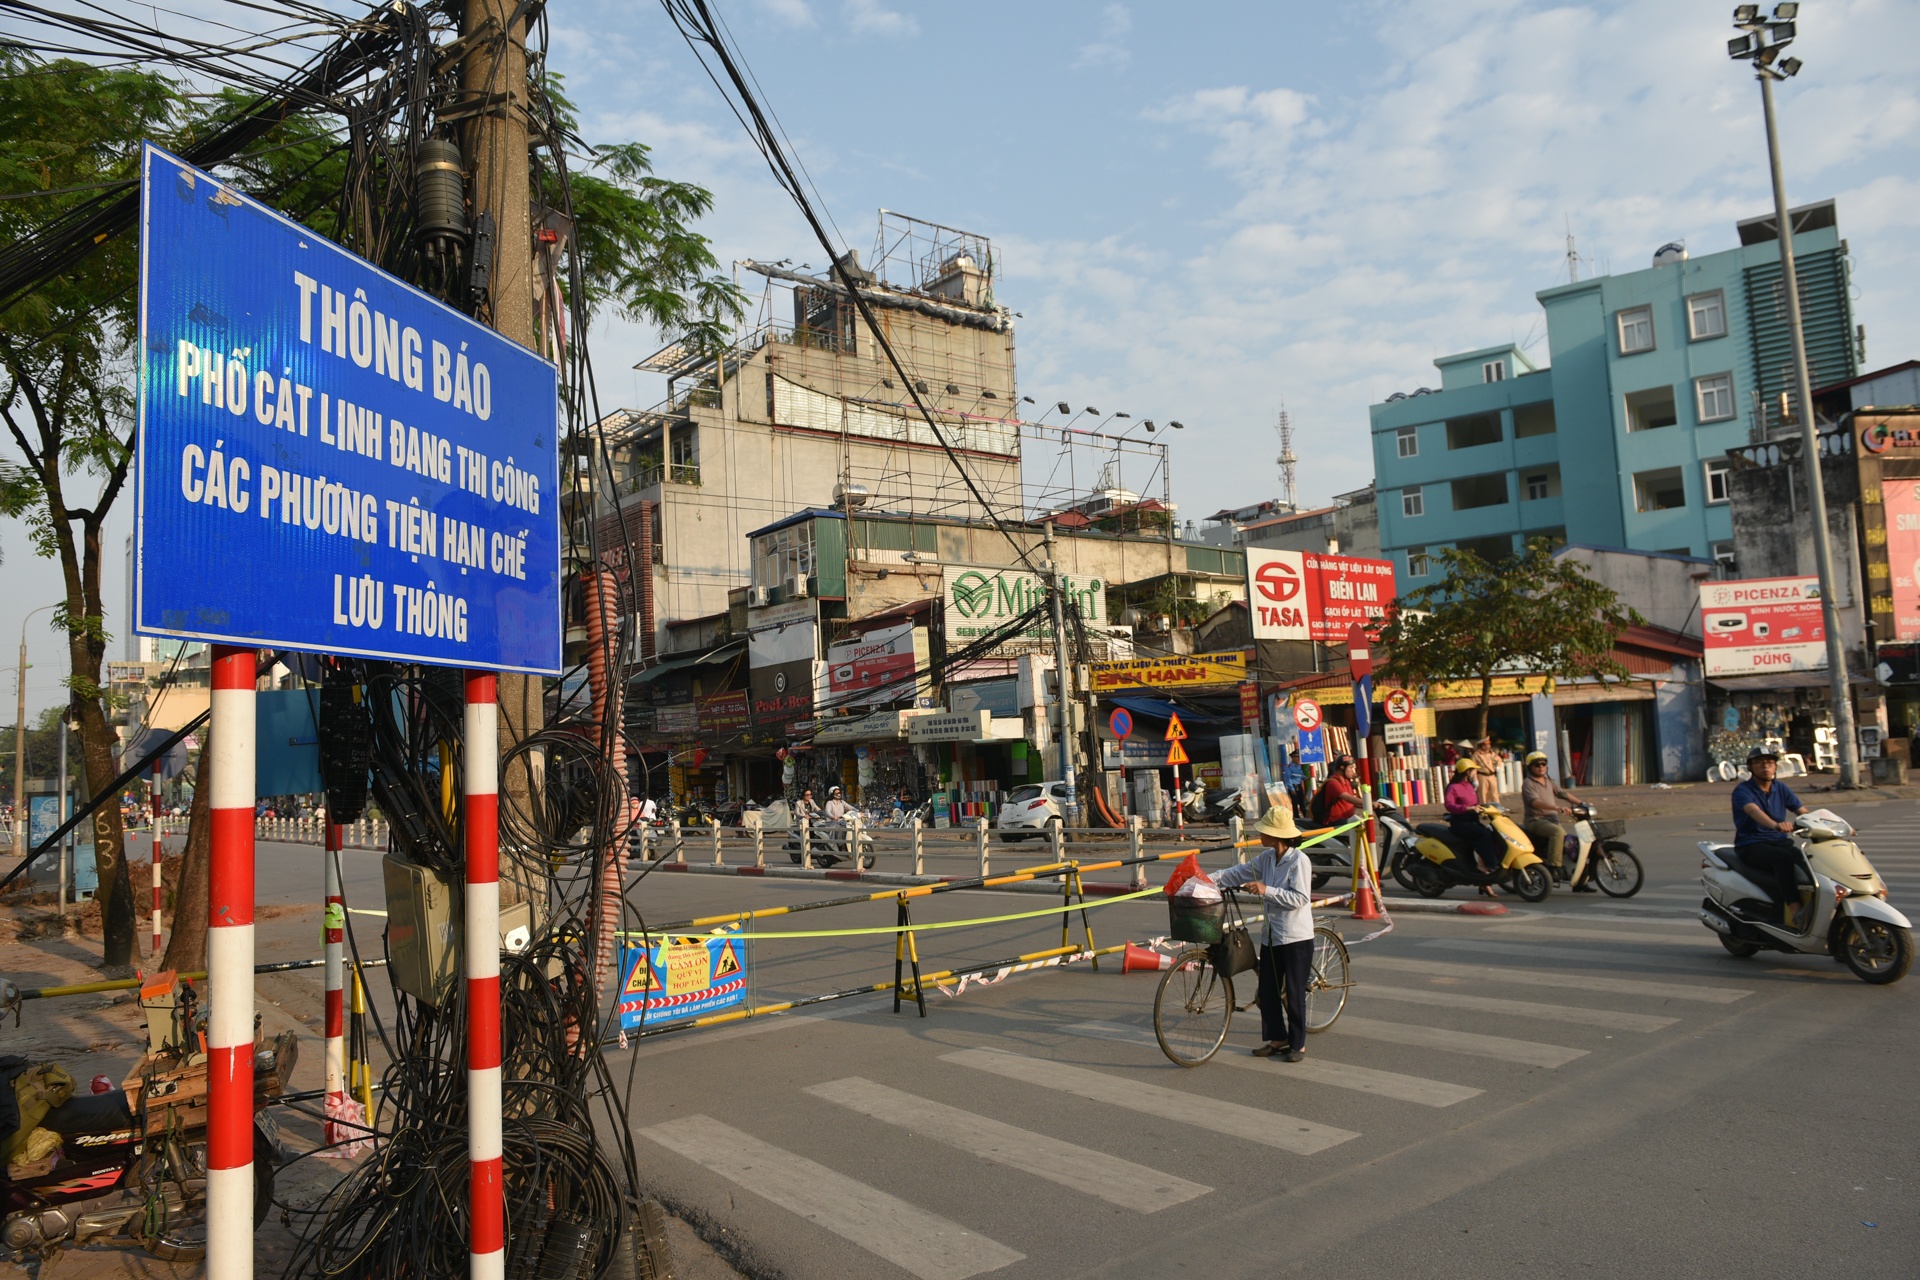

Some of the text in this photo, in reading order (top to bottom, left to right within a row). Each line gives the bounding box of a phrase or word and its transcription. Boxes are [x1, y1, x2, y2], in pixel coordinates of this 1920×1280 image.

[294, 271, 491, 421] THÔNG BÁO
[178, 340, 540, 515] PHỐ CÁT LINH ĐANG THI CÔNG
[182, 440, 530, 581] CÁC PHƯƠNG TIỆN HẠN CHẾ
[1320, 560, 1338, 570] HÀNG
[1338, 560, 1348, 573] VẬT
[1350, 562, 1362, 574] LIỆU
[1363, 563, 1374, 574] XÂY
[1376, 565, 1392, 577] DỰNG
[1356, 582, 1378, 602] LAN
[1734, 587, 1800, 601] PICENZA
[334, 574, 468, 644] LƯU THÔNG
[1258, 606, 1304, 628] TASA
[1324, 607, 1340, 618] GẠCH
[1341, 605, 1350, 617] ỐP
[1364, 606, 1385, 618] TASA
[956, 627, 976, 636] SEN
[854, 644, 885, 657] PICENZA
[1092, 663, 1110, 671] KHO
[1132, 660, 1150, 669] LIỆU
[1215, 655, 1237, 664] SINH
[1097, 672, 1142, 686] SINH
[1147, 666, 1206, 684] HẠNH
[639, 967, 646, 975] ĐI
[92, 1167, 115, 1175] HONDA
